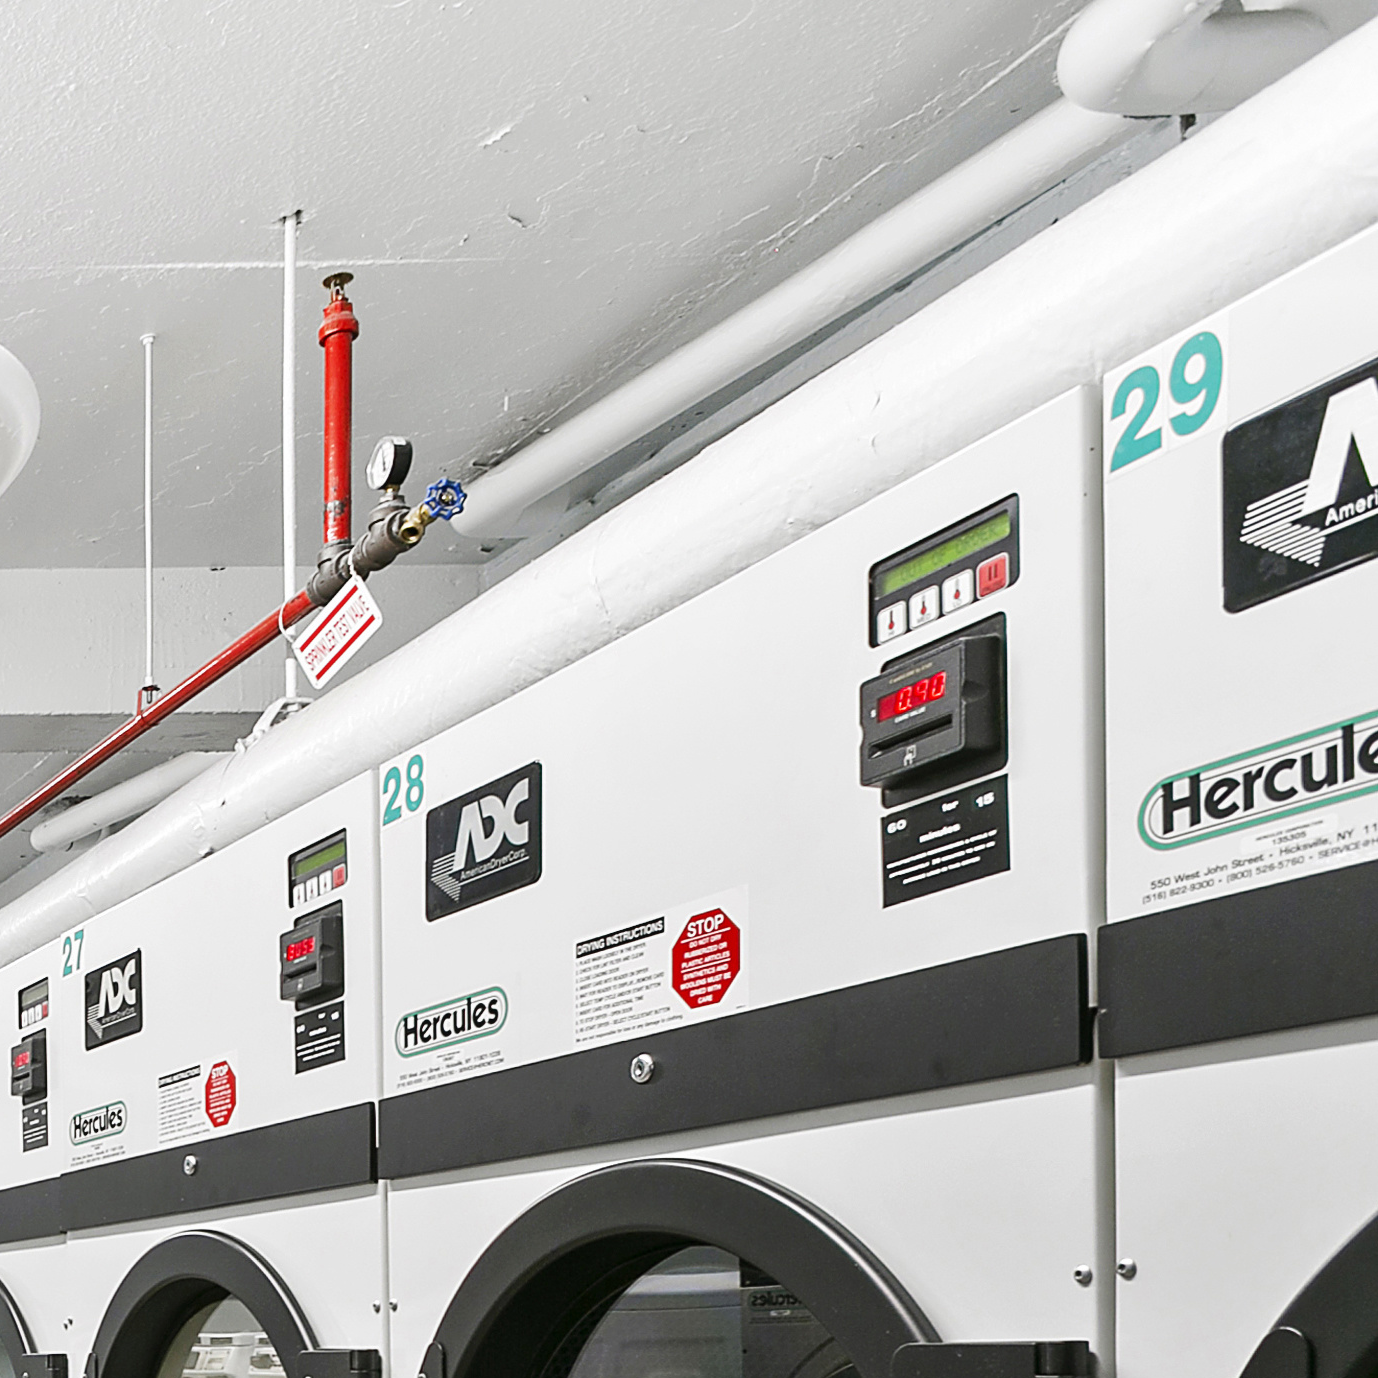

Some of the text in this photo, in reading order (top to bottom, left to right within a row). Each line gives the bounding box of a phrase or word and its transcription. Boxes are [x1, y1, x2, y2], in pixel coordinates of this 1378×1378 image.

[1110, 331, 1223, 473] 29
[305, 594, 370, 671] SPRINKLER TEST VALVE
[382, 754, 425, 827] 28
[975, 791, 995, 808] 15
[452, 777, 530, 873] ADC
[886, 819, 907, 834] 60
[918, 822, 962, 843] minutes
[1150, 876, 1171, 890] 550
[1173, 868, 1201, 884] West
[1203, 861, 1229, 876] John
[1231, 853, 1265, 869] Street
[1336, 828, 1354, 842] NY
[577, 920, 664, 956] DRYING INSTRUCTIONS
[687, 913, 725, 938] STOP
[63, 929, 84, 978] 27
[681, 957, 703, 969] PLASTIC
[98, 958, 137, 1015] ADC
[403, 996, 500, 1049] Hercules
[212, 1065, 229, 1079] STOP
[73, 1106, 123, 1139] Hercules
